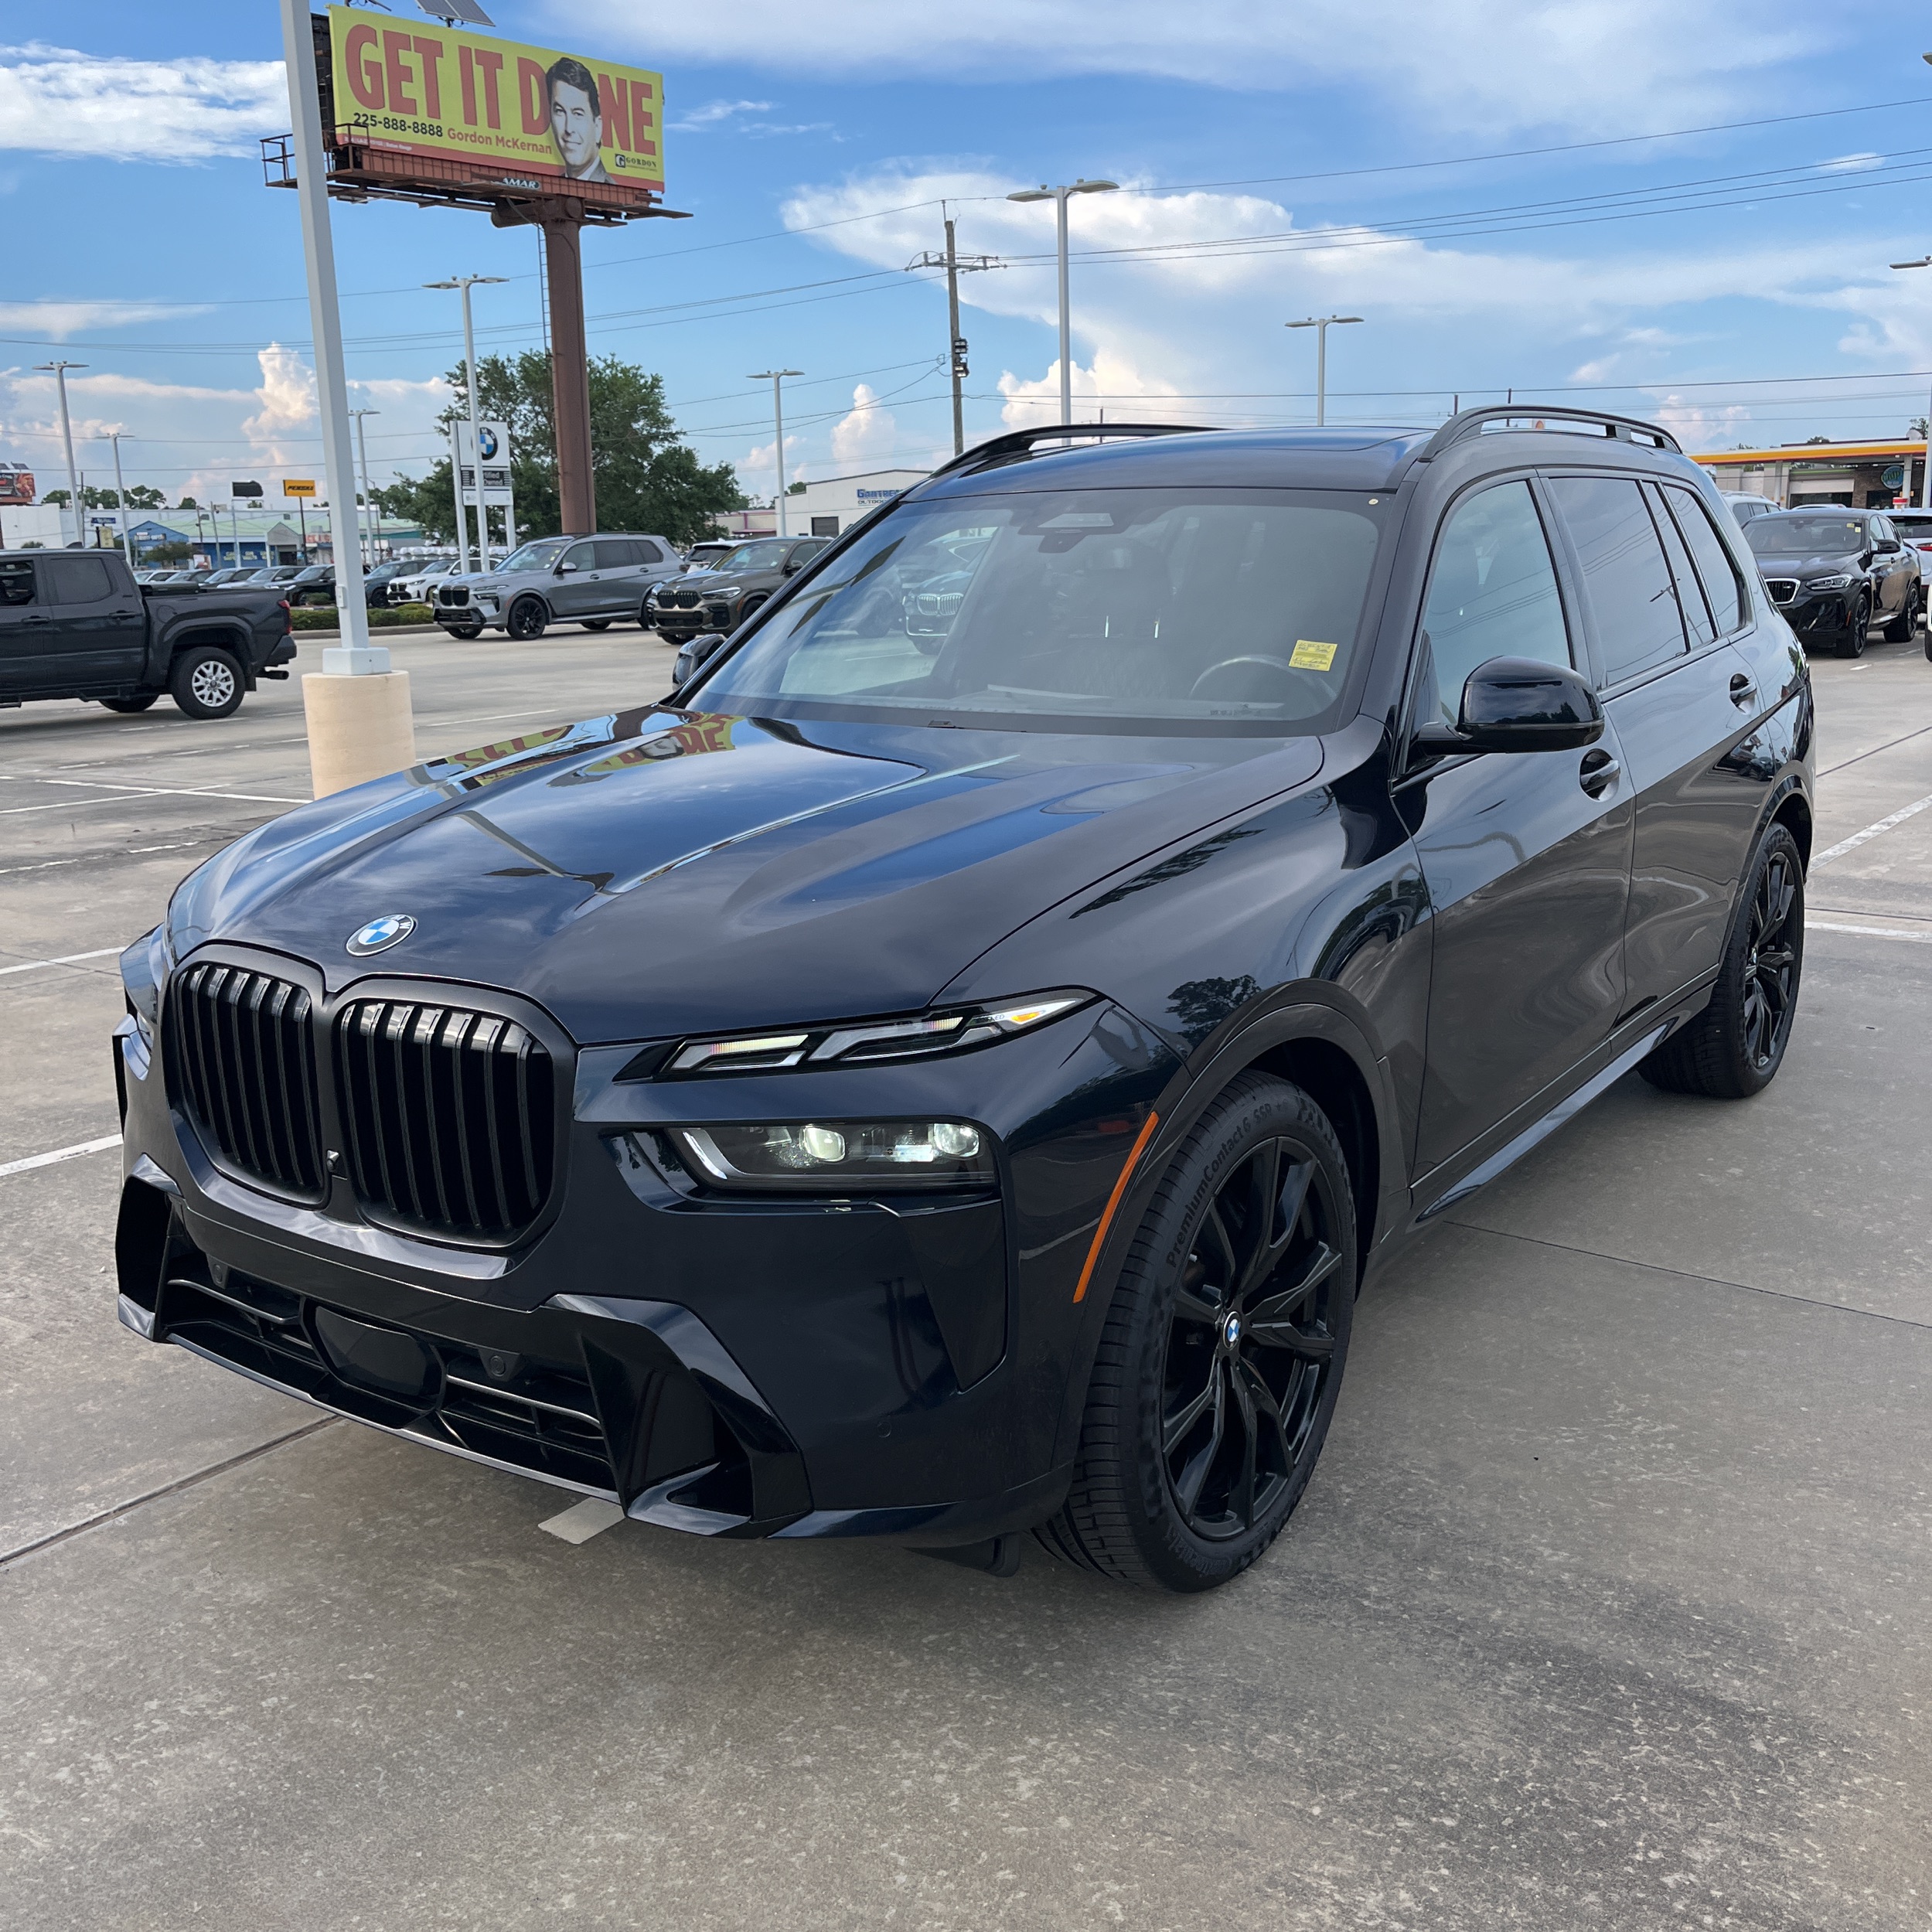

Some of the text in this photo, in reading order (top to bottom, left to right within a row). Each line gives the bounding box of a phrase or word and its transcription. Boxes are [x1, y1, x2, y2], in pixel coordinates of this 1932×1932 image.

[345, 24, 656, 155] GET IT DNE
[353, 112, 552, 155] 225-888-8888 Gordon McKernan
[503, 177, 537, 189] AMAR
[1166, 1126, 1244, 1268] PremiumContact
